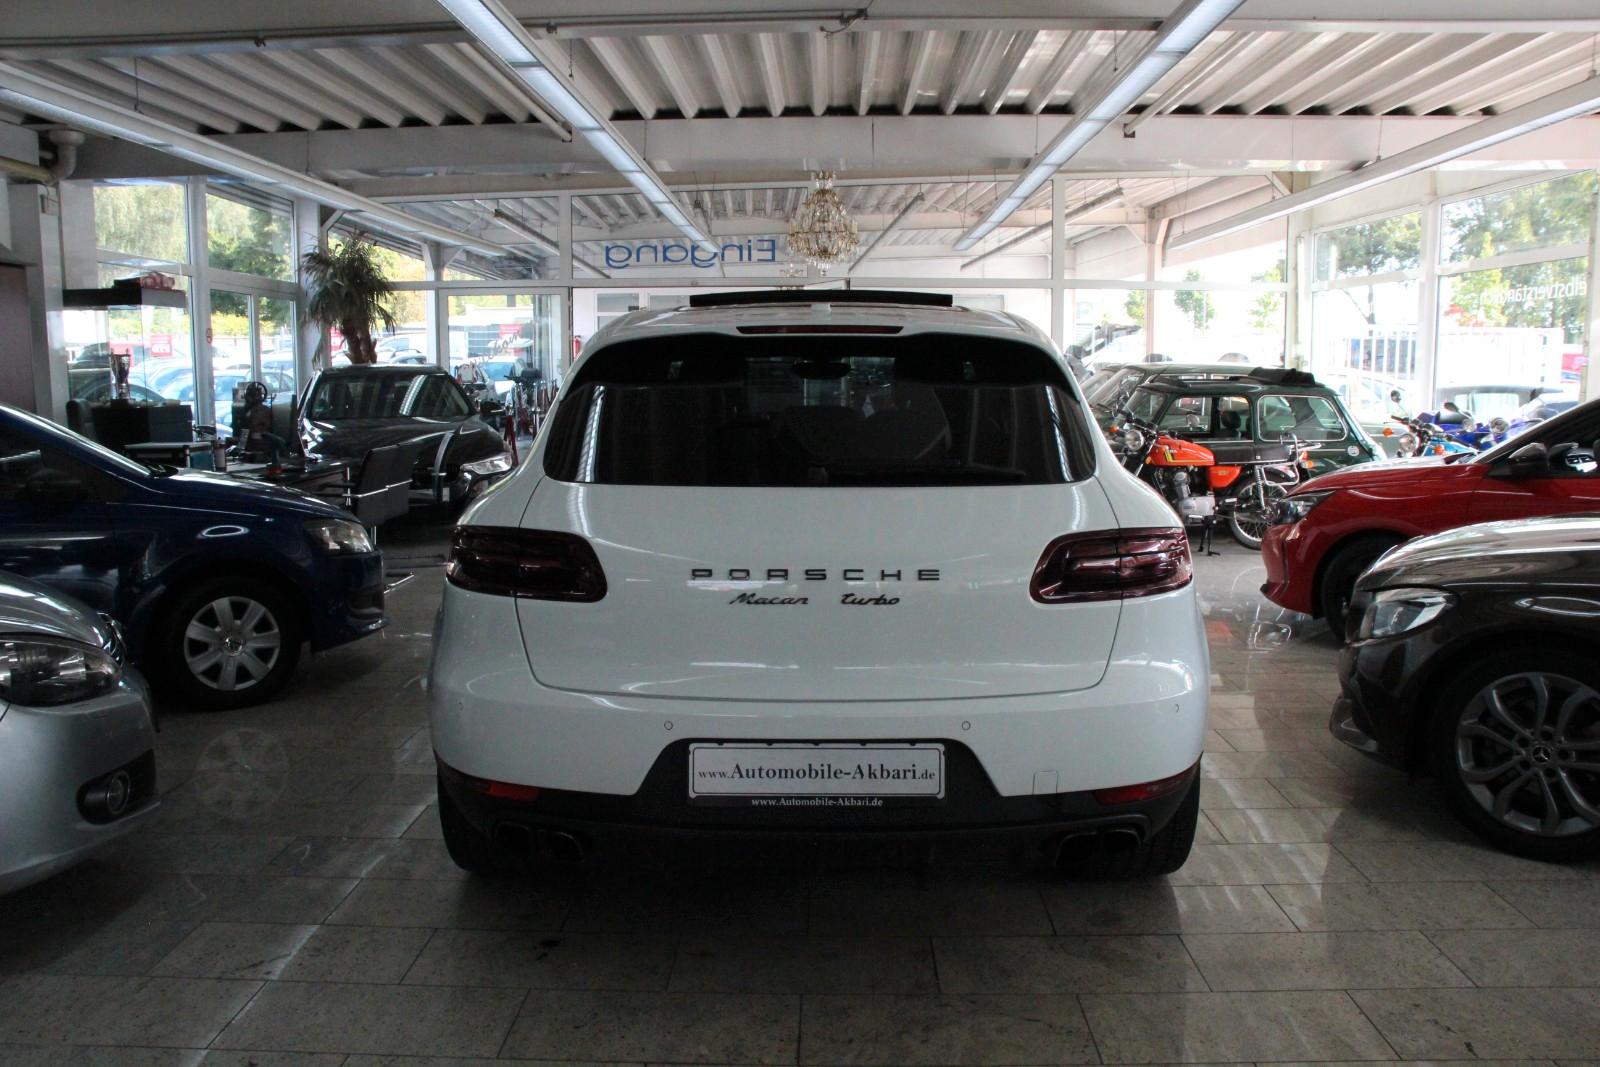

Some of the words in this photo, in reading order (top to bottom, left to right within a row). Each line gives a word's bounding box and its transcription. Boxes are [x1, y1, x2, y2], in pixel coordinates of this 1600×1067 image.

[691, 568, 940, 581] PORSCHE
[729, 592, 809, 605] Macan
[841, 593, 901, 605] turbo
[698, 763, 936, 780] www.Automobile-Akbari.de
[751, 797, 884, 808] www.Automobile-Akbari.de
